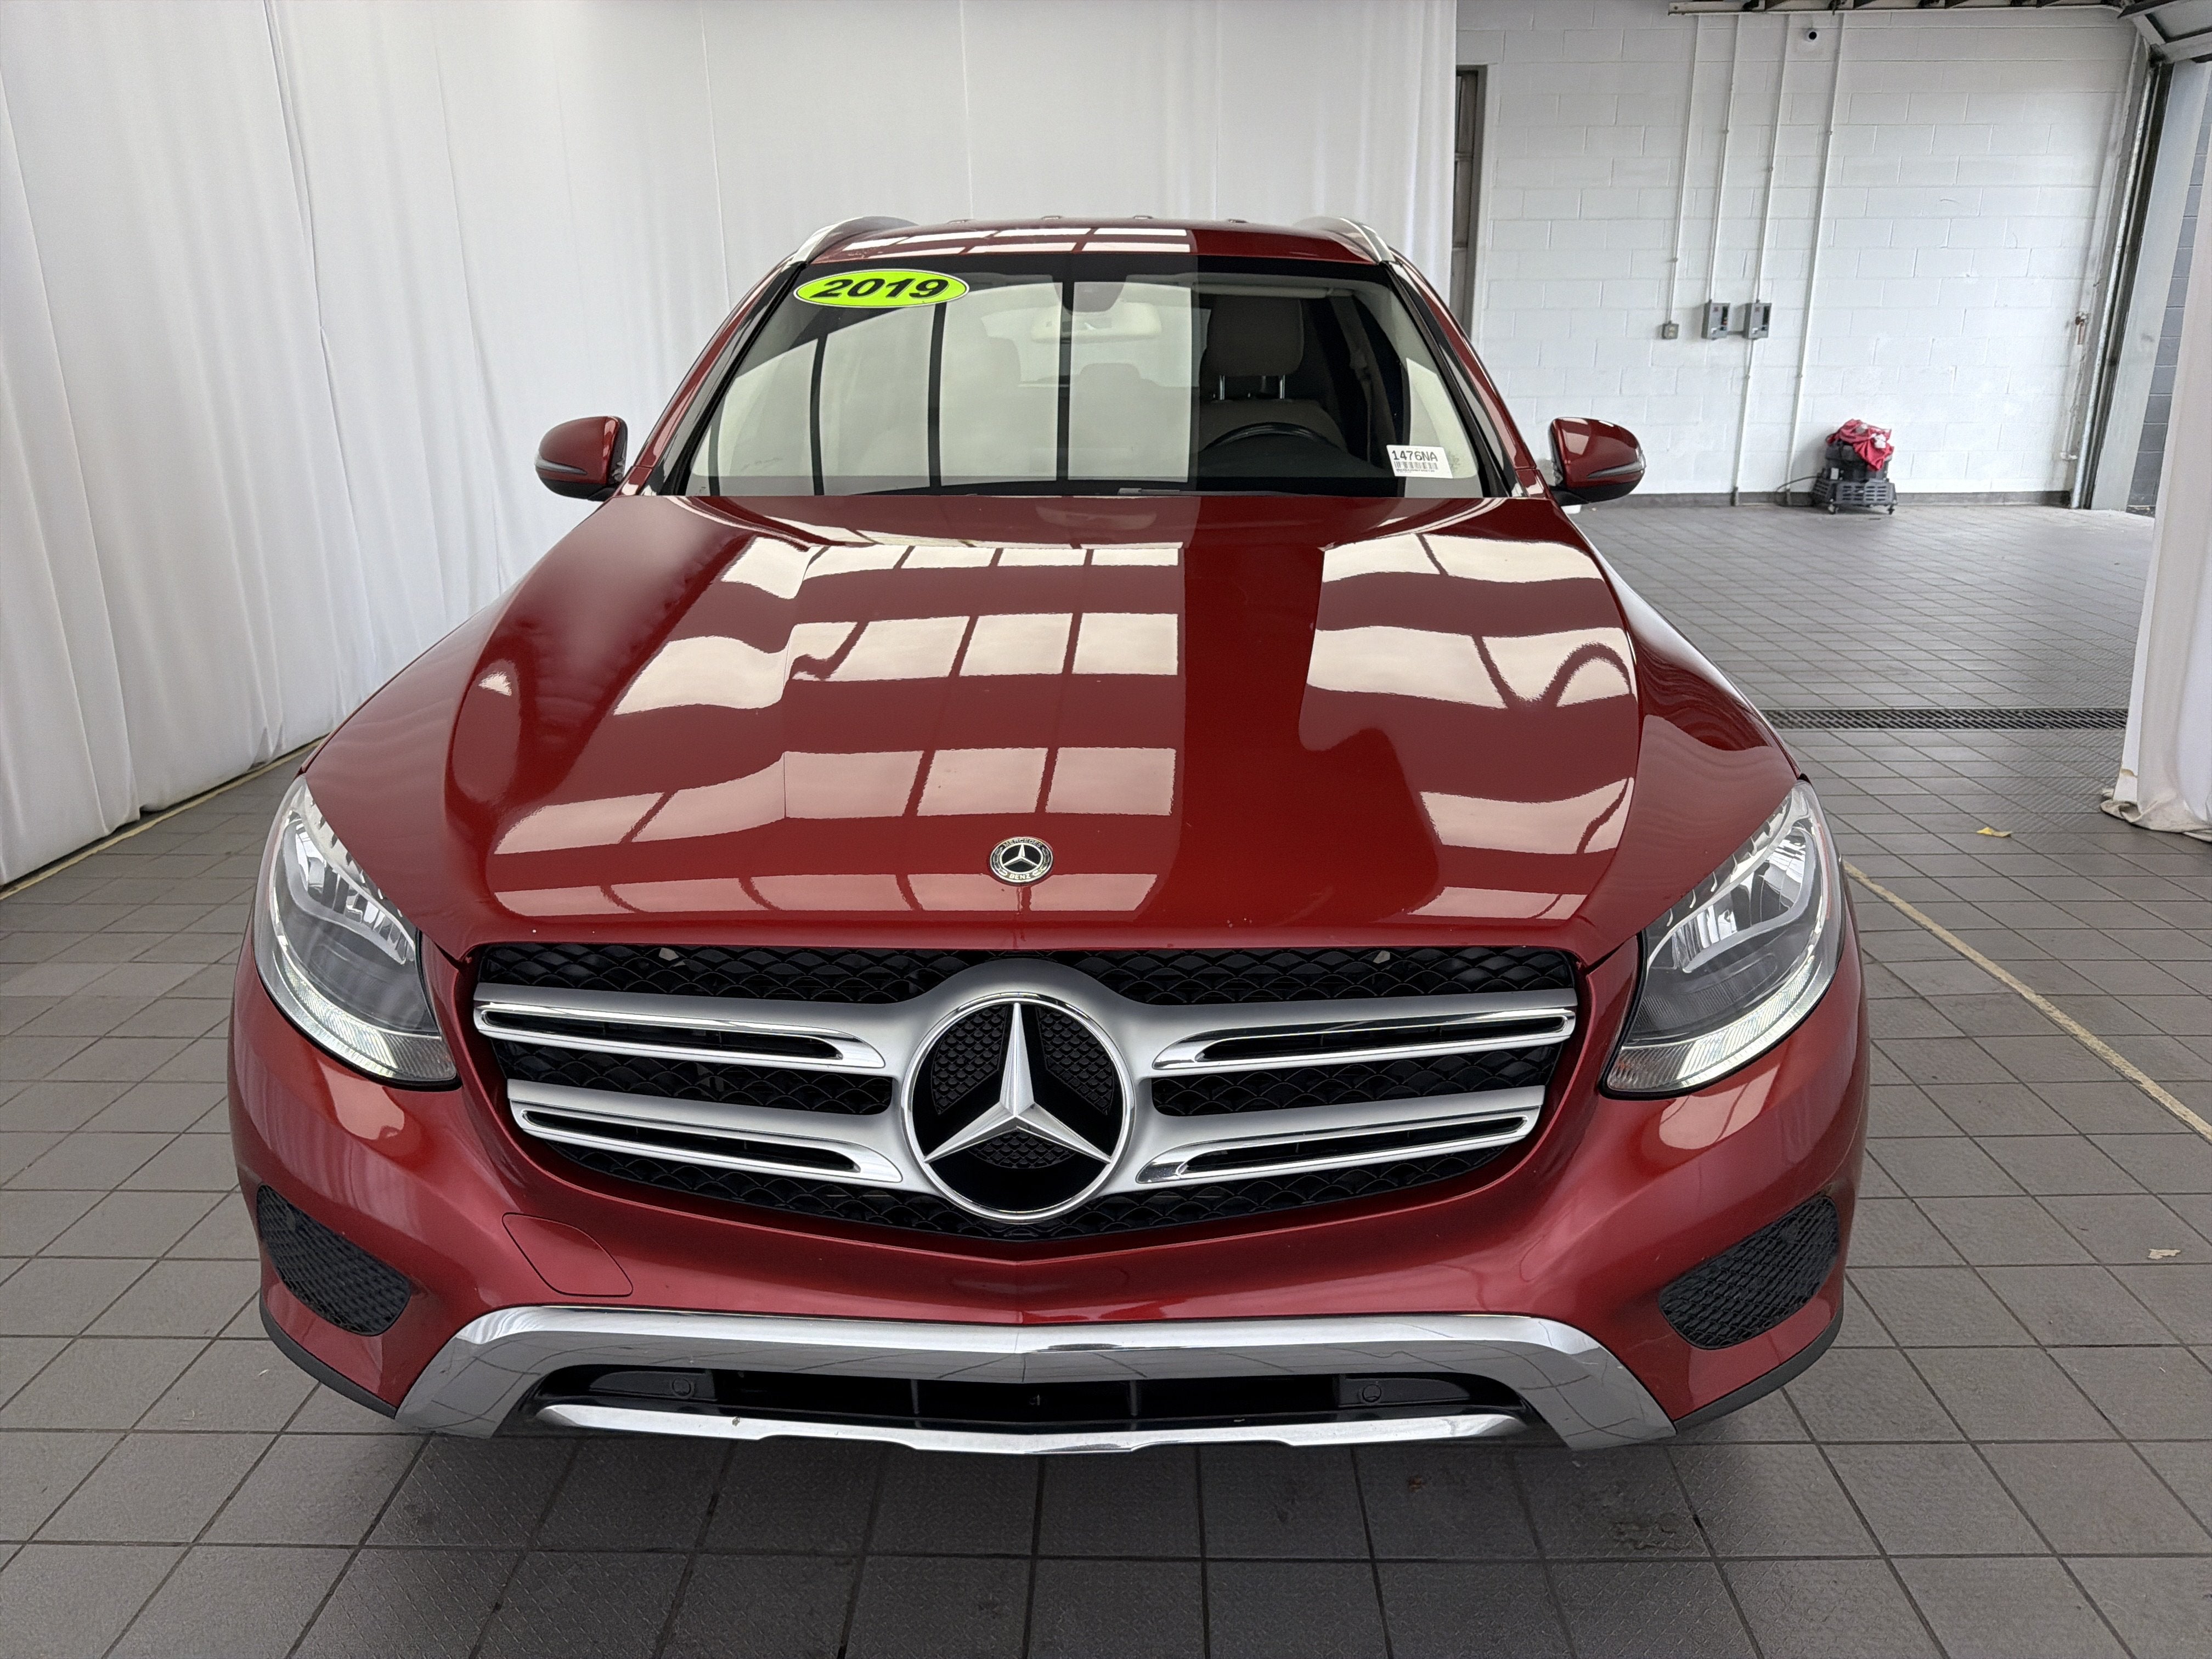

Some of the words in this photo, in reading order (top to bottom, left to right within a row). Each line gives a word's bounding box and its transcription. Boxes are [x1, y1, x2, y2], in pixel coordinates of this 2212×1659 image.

[809, 278, 950, 299] 2019
[1392, 450, 1438, 461] 1476NA
[1003, 838, 1042, 848] MERCEDES
